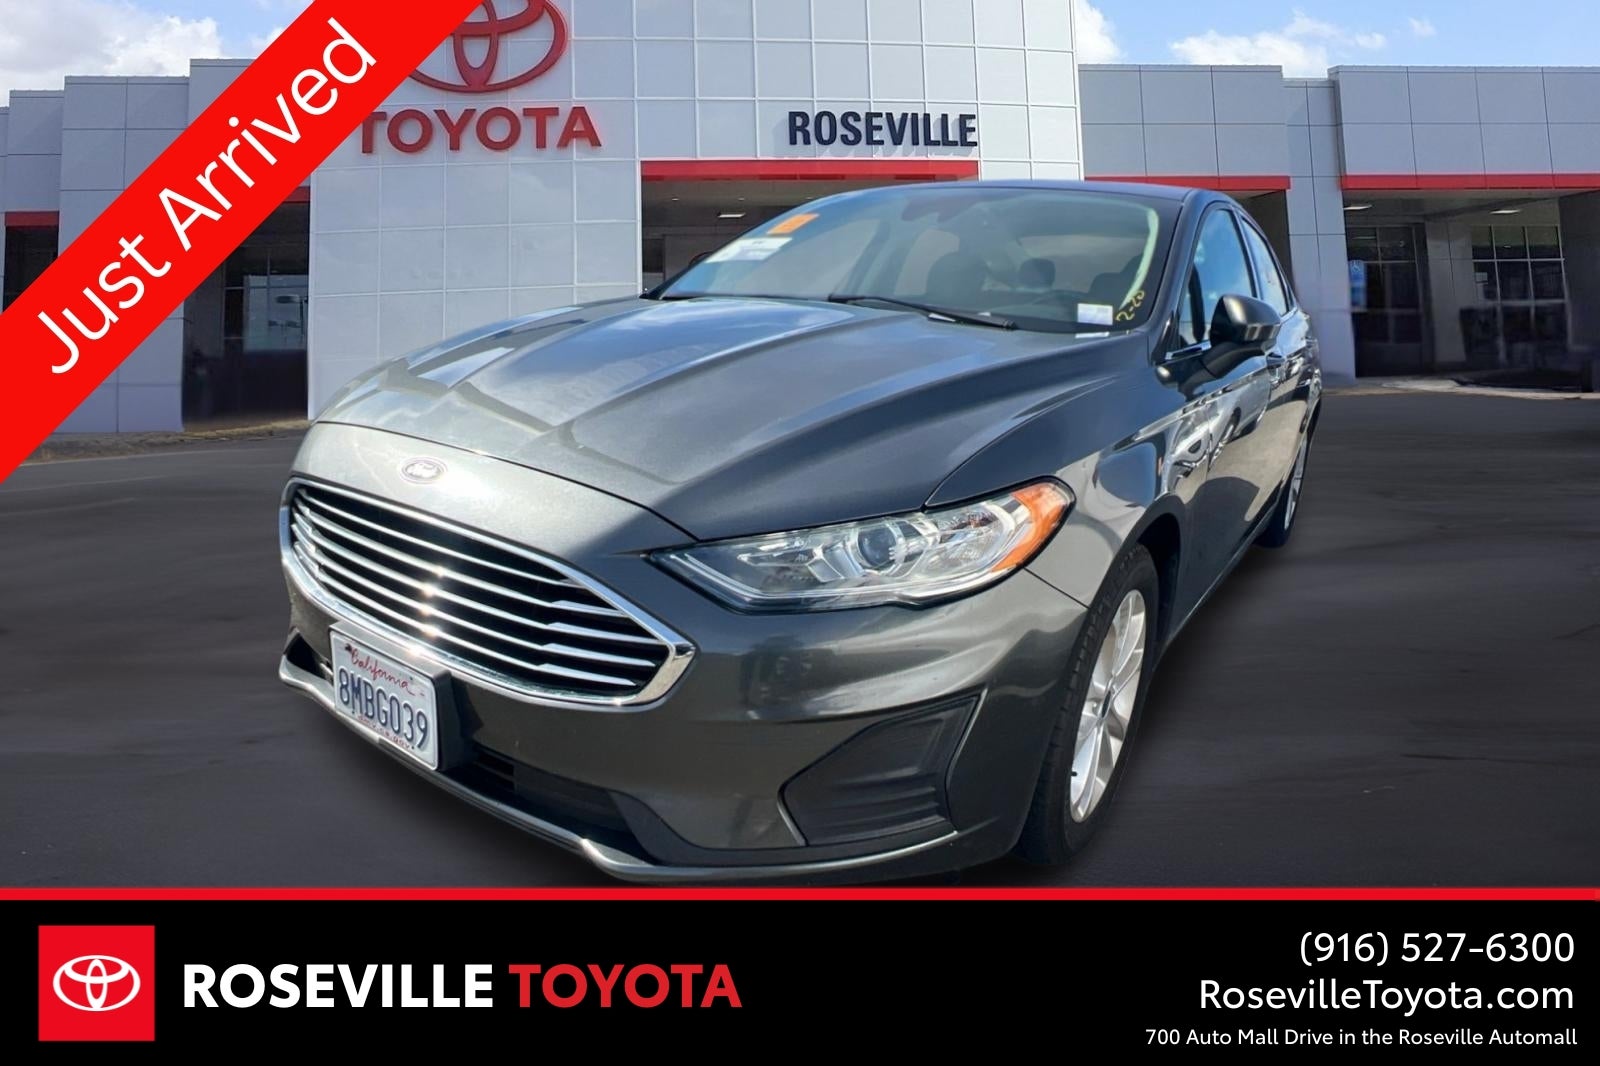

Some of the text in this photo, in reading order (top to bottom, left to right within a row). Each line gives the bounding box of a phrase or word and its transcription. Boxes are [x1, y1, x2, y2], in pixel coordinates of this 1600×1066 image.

[361, 106, 602, 154] TOYOTA
[788, 110, 978, 147] ROSEVILLE
[350, 647, 416, 697] California
[338, 665, 429, 749] 8MBG039
